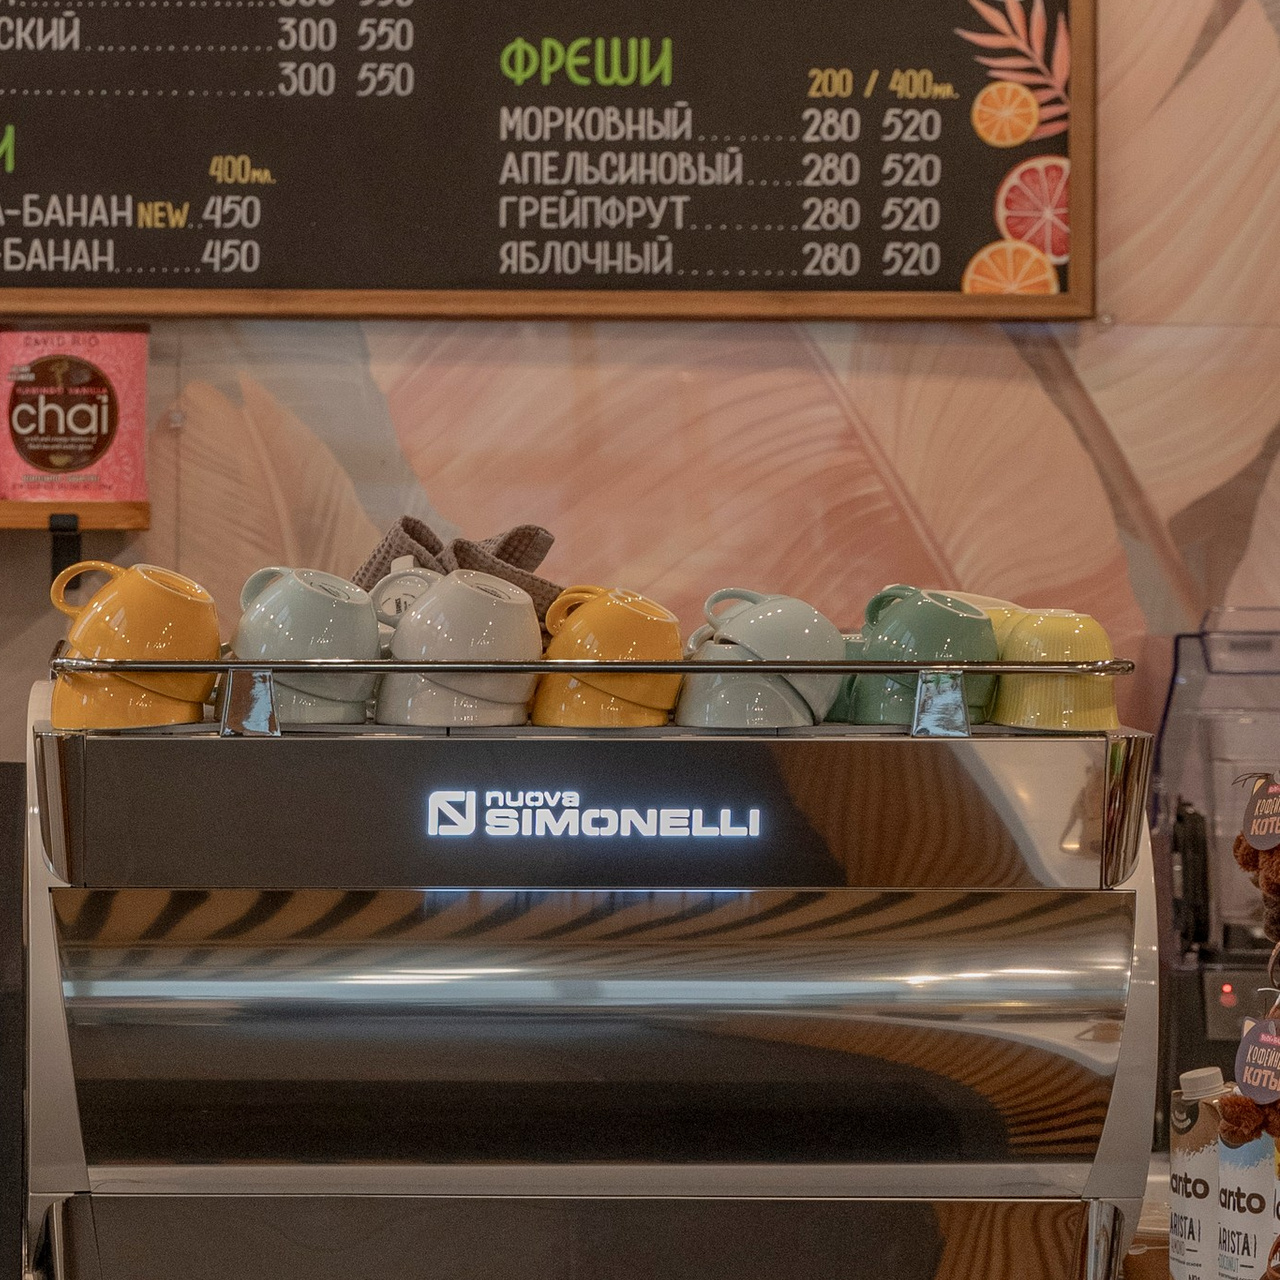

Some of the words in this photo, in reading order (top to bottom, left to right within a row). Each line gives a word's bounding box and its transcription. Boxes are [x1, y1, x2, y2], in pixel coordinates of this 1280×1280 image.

[278, 18, 337, 51] 300
[358, 18, 414, 50] 550
[501, 38, 671, 85] ФРЕШИ
[279, 62, 335, 96] 300
[358, 63, 414, 96] 550
[500, 101, 692, 141] МОРКОВНЫЙ
[803, 108, 860, 142] 280
[883, 108, 941, 141] 520
[500, 147, 743, 185] АПЕЛЬСИНОВЫЙ
[803, 153, 860, 186] 280
[883, 153, 941, 186] 520
[203, 195, 261, 228] 450
[499, 189, 690, 229] ГРЕЙПФРУТ
[803, 197, 860, 230] 280
[882, 197, 940, 231] 520
[202, 239, 260, 272] 450
[499, 235, 673, 274] ЯБЛОЧНЫЙ
[803, 242, 860, 275] 280
[883, 242, 940, 276] 520
[486, 791, 579, 807] nuova
[485, 809, 760, 836] SIMONELLI
